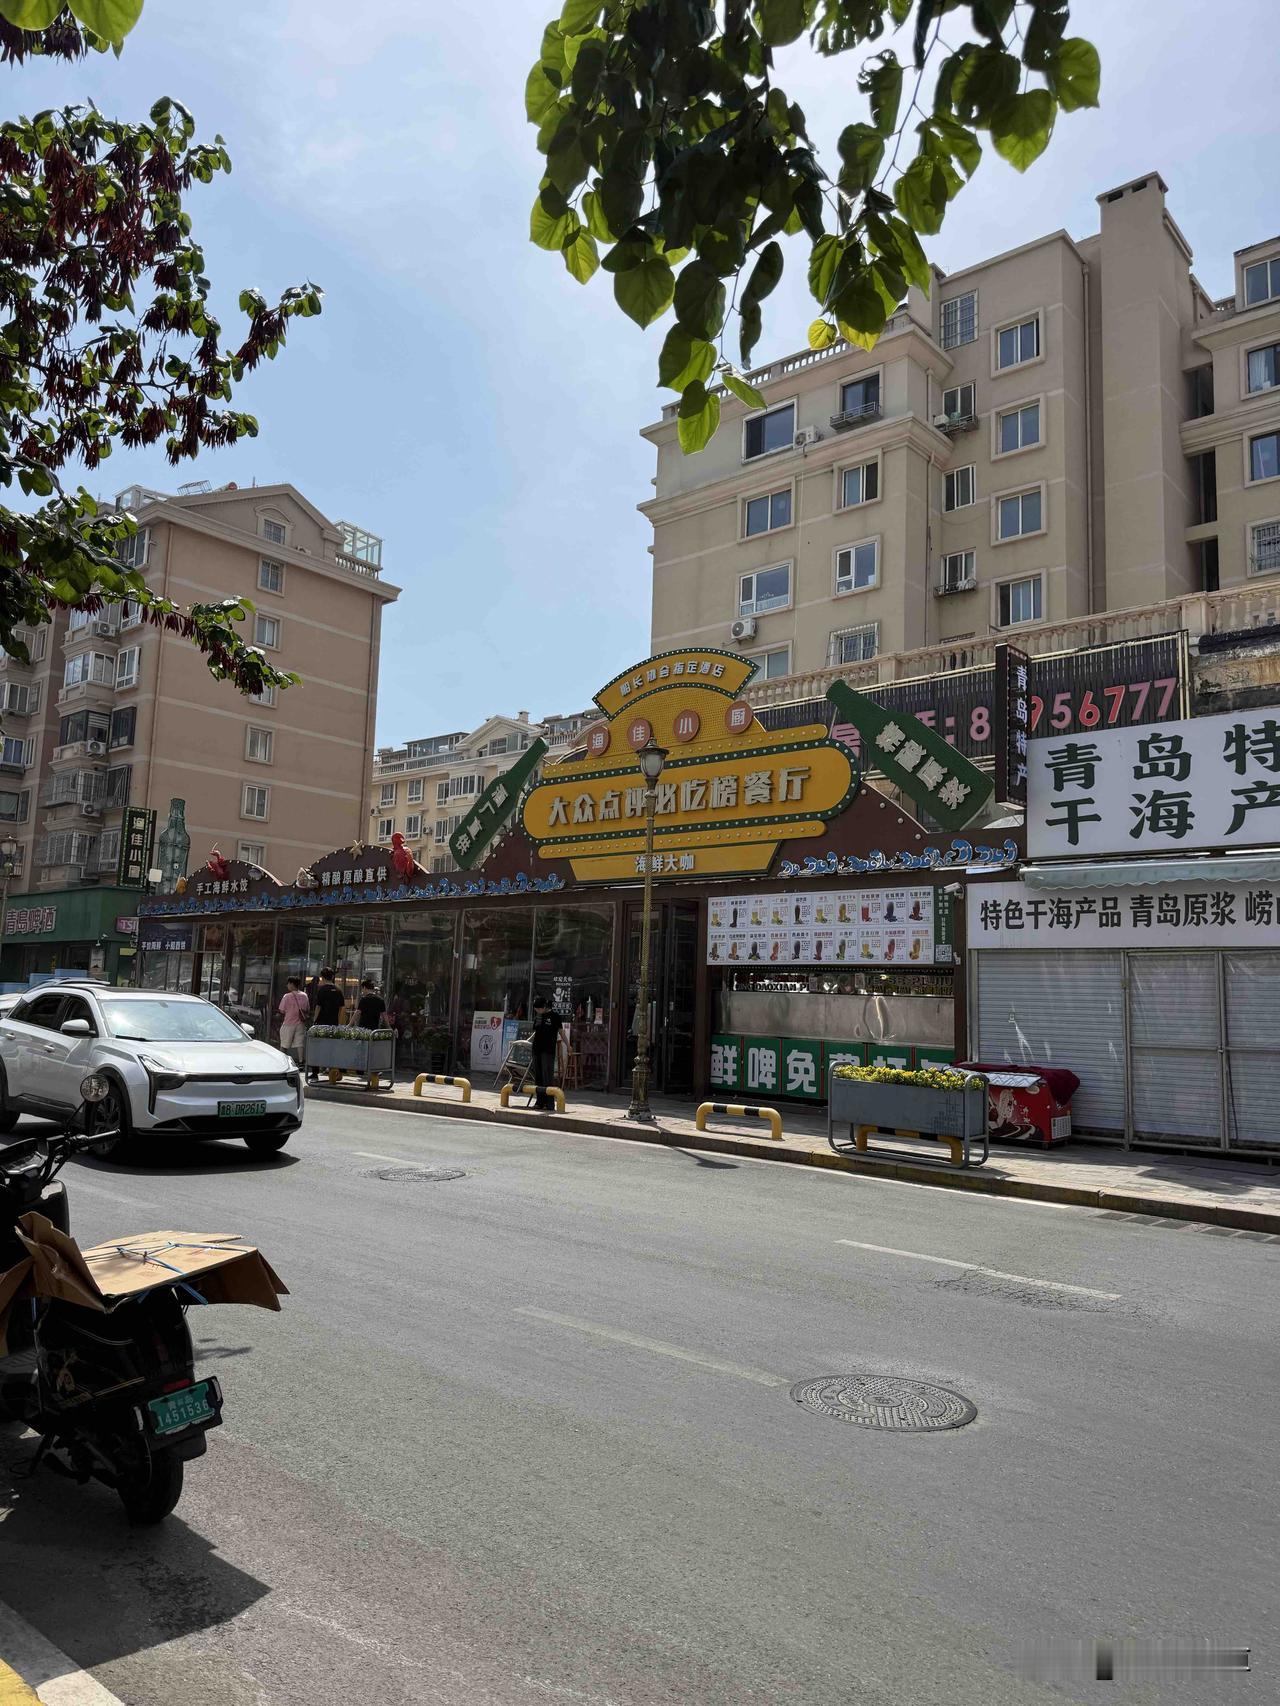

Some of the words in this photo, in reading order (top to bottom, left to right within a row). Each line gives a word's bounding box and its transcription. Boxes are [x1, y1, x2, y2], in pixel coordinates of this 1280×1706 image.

[1044, 719, 1280, 792] 青岛特
[548, 766, 812, 827] 大众点评必吃榜餐厅
[1045, 779, 1280, 846] 干海产
[634, 853, 695, 873] 海鲜大咖
[196, 878, 248, 896] 手工海鲜水饺
[6, 906, 57, 935] 青岛啤酒
[980, 897, 1122, 931] 特色干海产品
[1129, 891, 1237, 928] 青岛原浆
[1245, 889, 1280, 926] 崂
